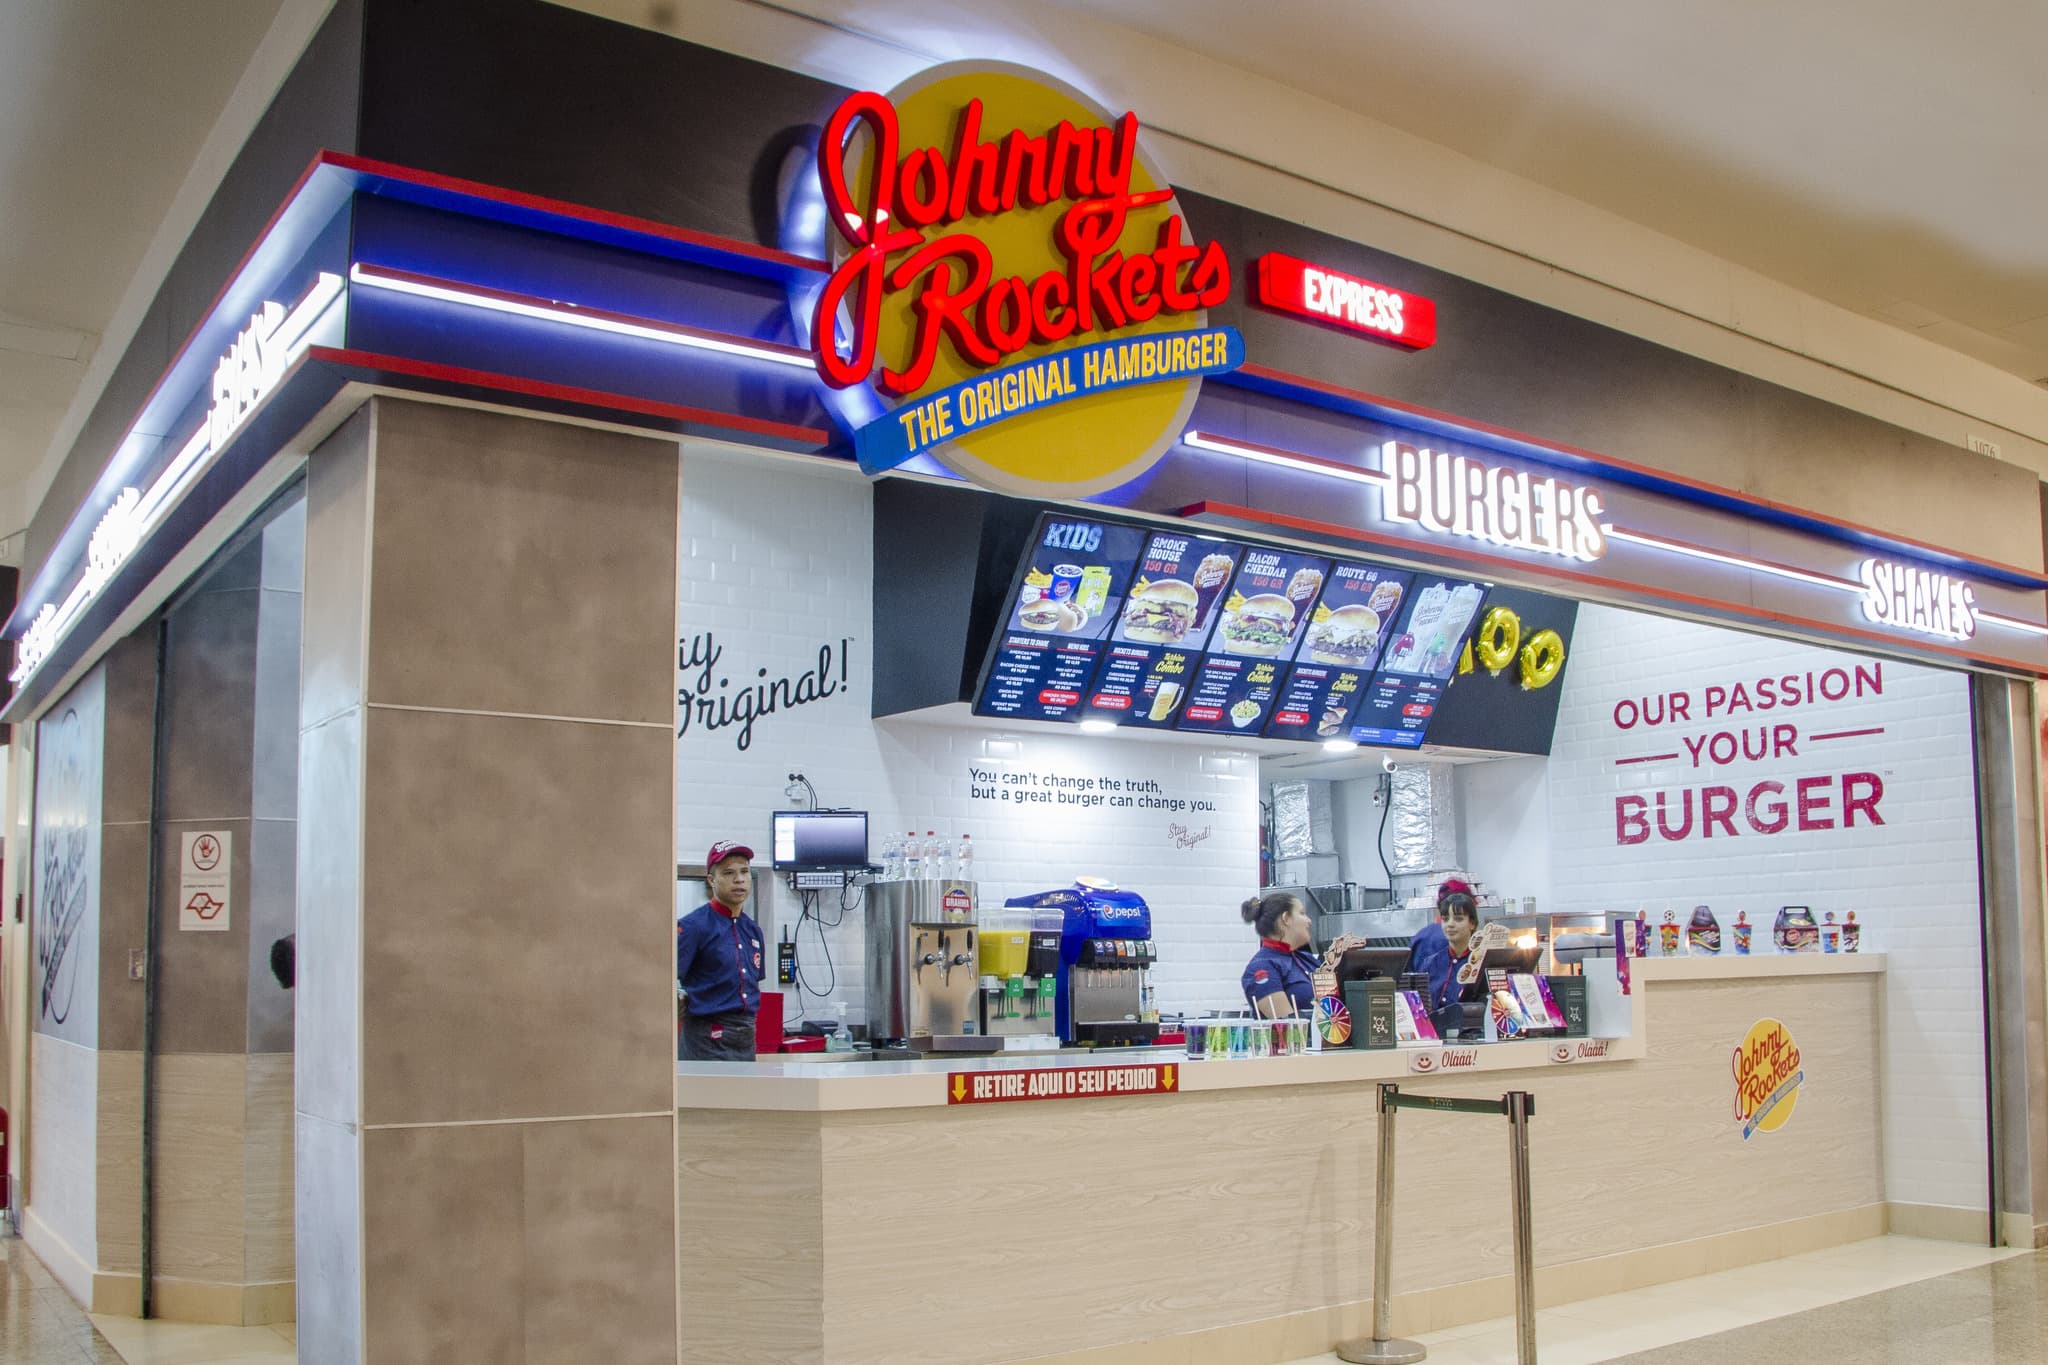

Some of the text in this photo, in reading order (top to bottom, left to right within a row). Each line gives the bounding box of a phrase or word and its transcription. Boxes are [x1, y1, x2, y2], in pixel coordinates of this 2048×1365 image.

[811, 91, 1175, 390] Johnny
[877, 215, 1231, 397] Rockets
[1303, 267, 1404, 335] EXPRESS
[899, 332, 1229, 454] THE ORIGINAL HAMBURGER
[1382, 441, 1607, 562] BURGERS
[1043, 522, 1103, 552] KIDS
[1152, 537, 1188, 552] SMOKE
[1144, 559, 1178, 575] 150 GR
[1147, 547, 1182, 562] HOUSE
[1247, 552, 1281, 566] BACON
[1244, 563, 1287, 579] CHEEDAR
[1252, 575, 1284, 589] 150 GR
[1335, 565, 1365, 580] ROUTE
[1343, 579, 1373, 592] 150 GR
[1860, 559, 1976, 641] SHAKES
[1155, 661, 1185, 674] Combo
[1613, 662, 1883, 729] OUR PASSION
[1682, 723, 1799, 768] YOUR
[969, 768, 1162, 795] You can't change the truth,
[971, 785, 1217, 813] but a great burger can change you.
[1615, 771, 1886, 845] BURGER
[1167, 822, 1188, 839] Stay
[1115, 906, 1141, 919] pepsi
[974, 1067, 1157, 1099] RETIRE AQUI O SEU PEDIDO
[1732, 1023, 1789, 1121] Johnny
[1744, 1046, 1800, 1120] Rockets
